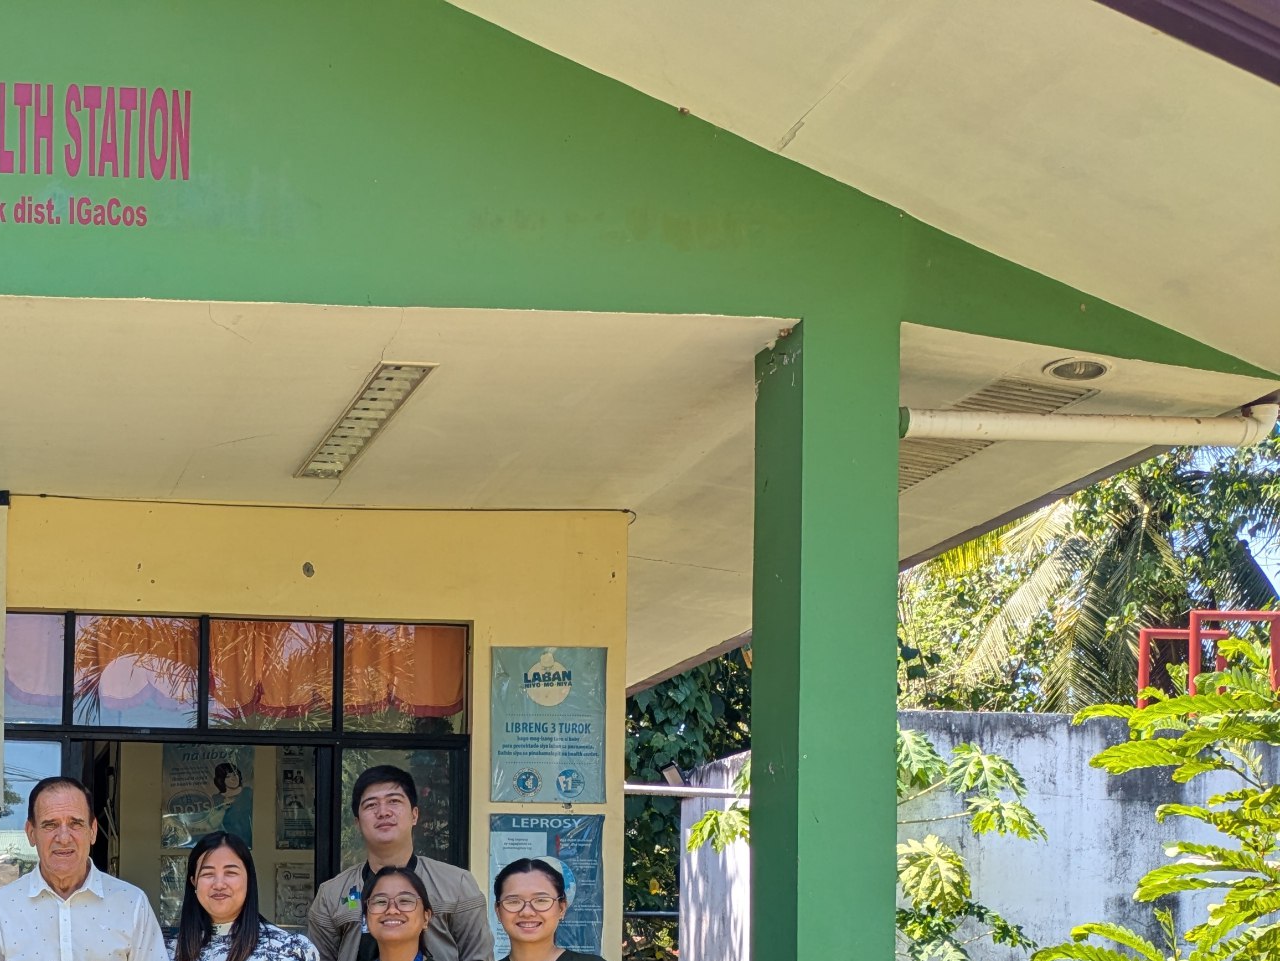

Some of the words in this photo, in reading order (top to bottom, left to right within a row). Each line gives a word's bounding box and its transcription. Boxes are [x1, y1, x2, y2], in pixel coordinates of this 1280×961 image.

[64, 83, 192, 181] STATION
[13, 196, 61, 225] dist.
[70, 197, 148, 227] IGaCos
[523, 670, 572, 683] LABAN
[505, 722, 548, 734] LIBRENG
[550, 723, 556, 733] 3
[559, 722, 592, 734] TUROK
[512, 817, 581, 828] LEPROSY
